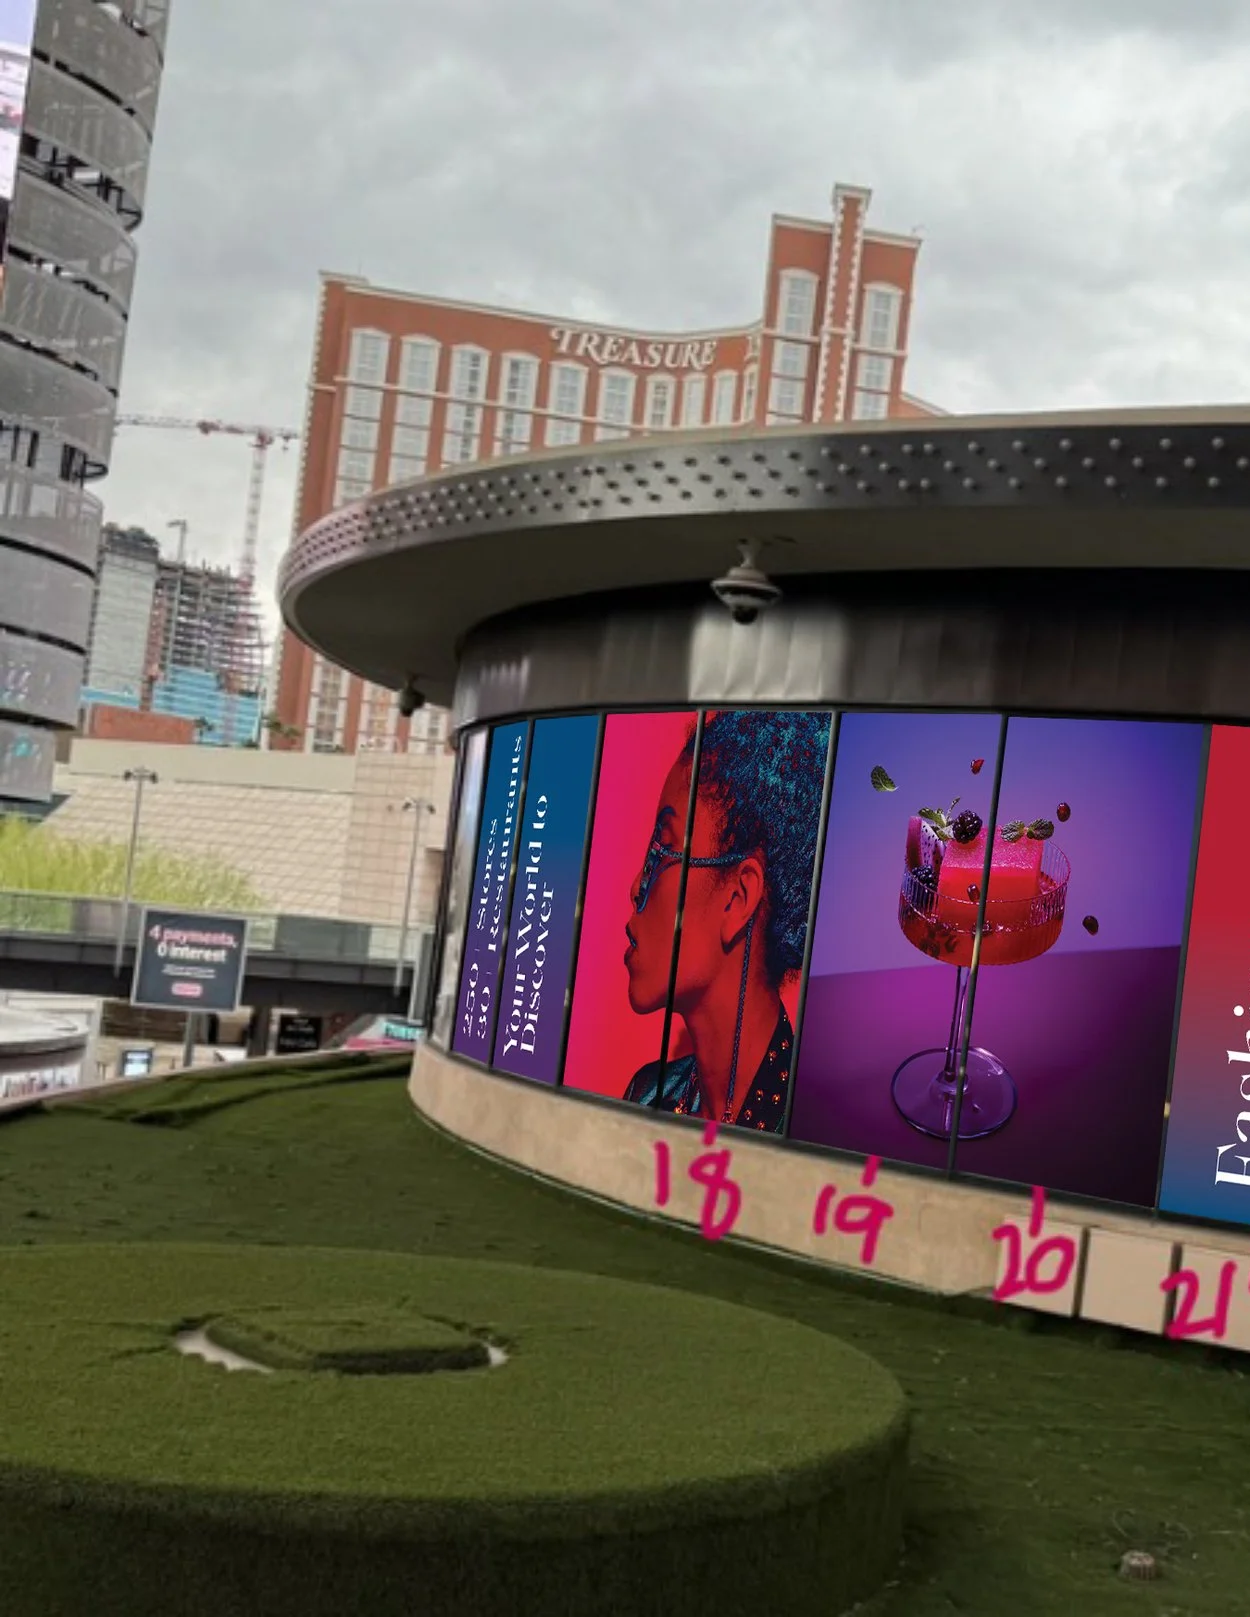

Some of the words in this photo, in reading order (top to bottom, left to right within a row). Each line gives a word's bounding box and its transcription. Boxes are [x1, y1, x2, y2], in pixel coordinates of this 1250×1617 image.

[551, 327, 717, 370] TREASURE
[488, 735, 522, 952] Restaurants
[532, 795, 548, 830] to
[477, 819, 498, 930] Stores
[514, 840, 542, 959] World
[503, 963, 526, 1056] Your
[520, 881, 554, 1055] Discover
